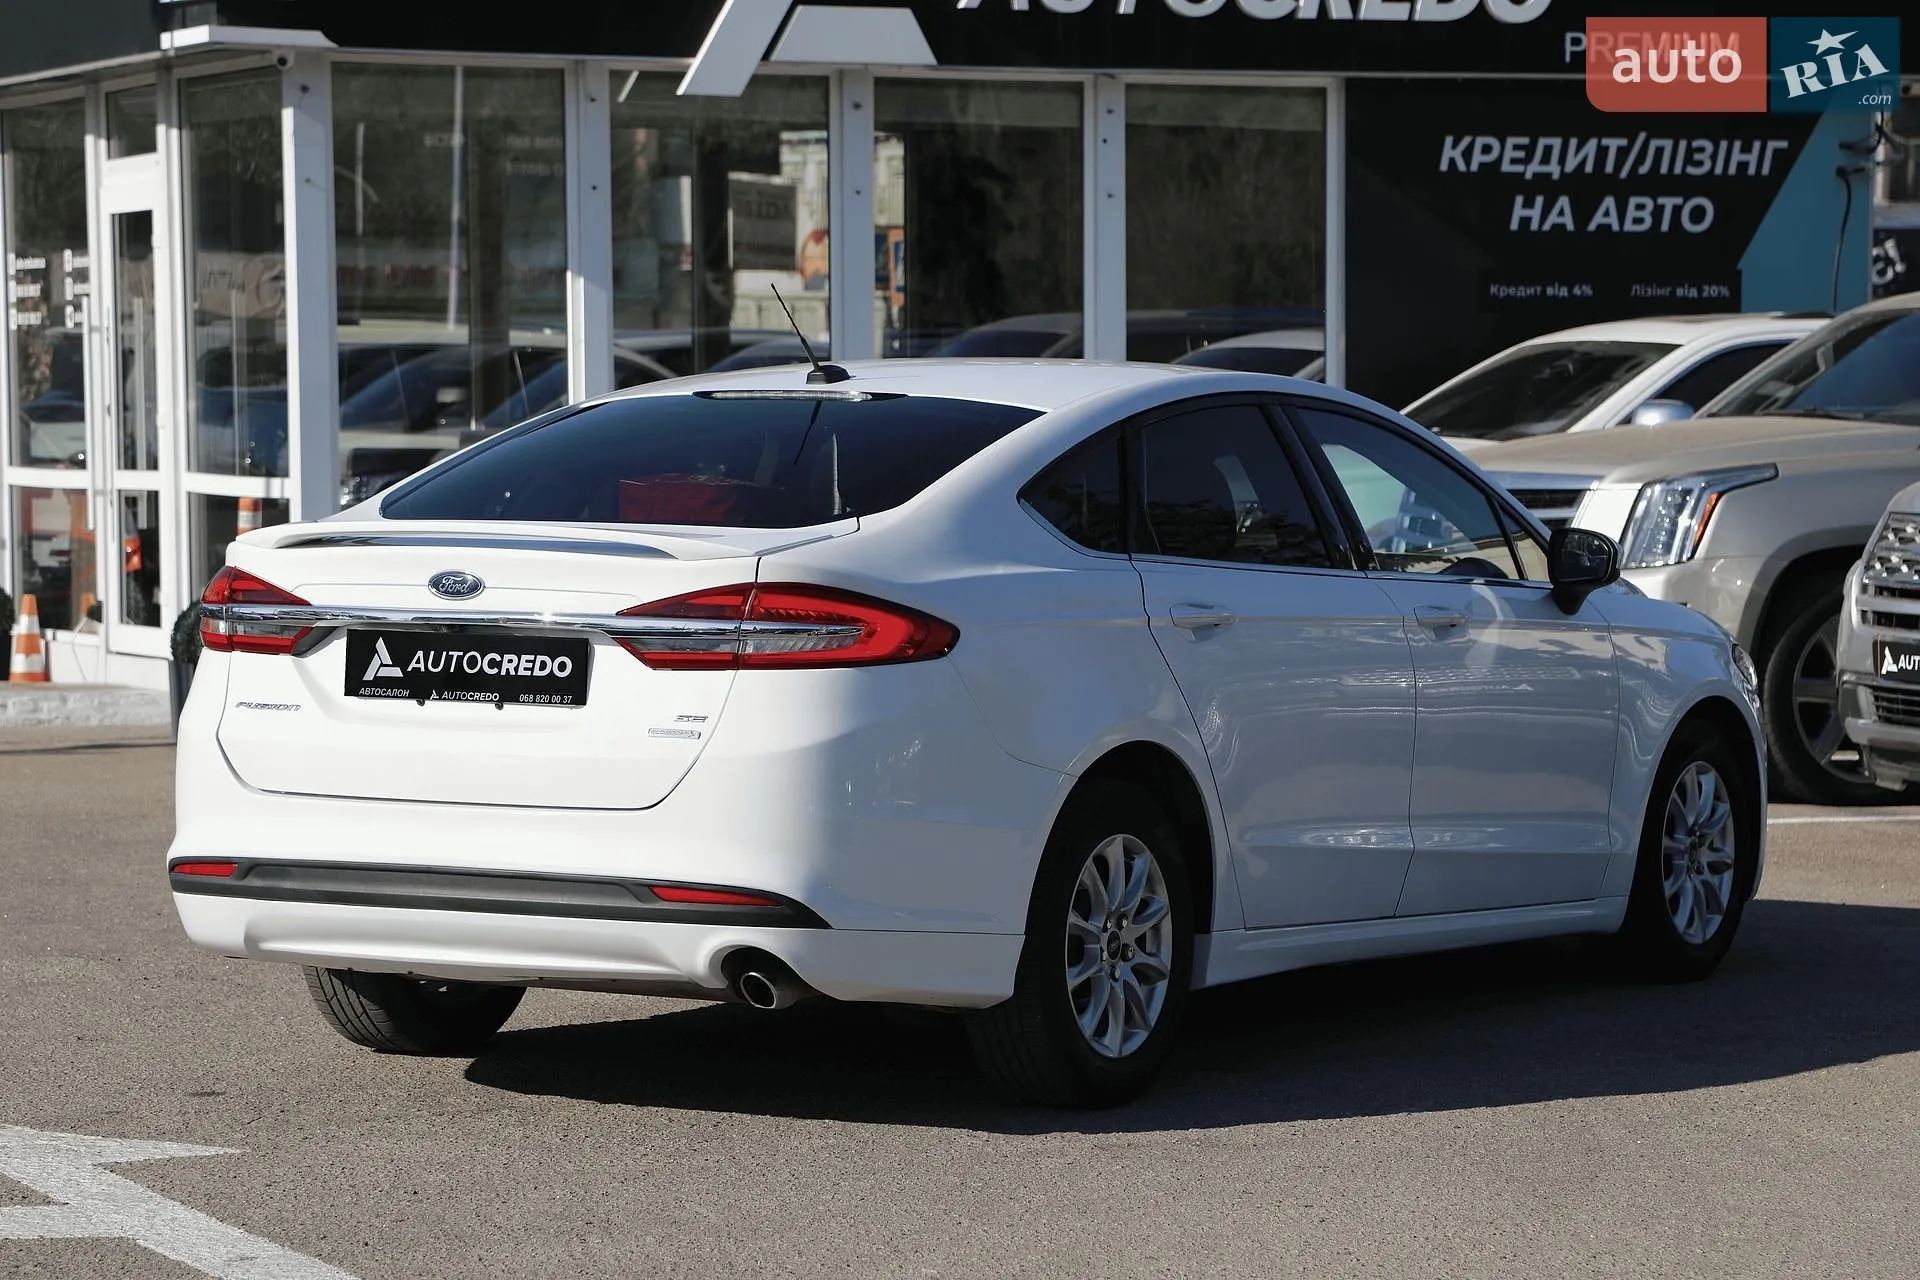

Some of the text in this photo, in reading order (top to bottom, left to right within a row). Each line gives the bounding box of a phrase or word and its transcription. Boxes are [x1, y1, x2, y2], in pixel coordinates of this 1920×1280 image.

[1438, 131, 1790, 181] КРЕДИТ/ЛІЗІНГ
[1509, 194, 1716, 235] НА АВТО
[1489, 283, 1542, 300] Кредит
[1546, 282, 1569, 297] від
[1630, 283, 1731, 298] Лізінг від 20%
[438, 575, 471, 593] Ford
[406, 649, 574, 679] AUTOCREDO
[358, 687, 410, 698] АВТОСАЛОН
[441, 691, 500, 702] AUTOCREDO
[519, 693, 573, 705] 068 820 00 37
